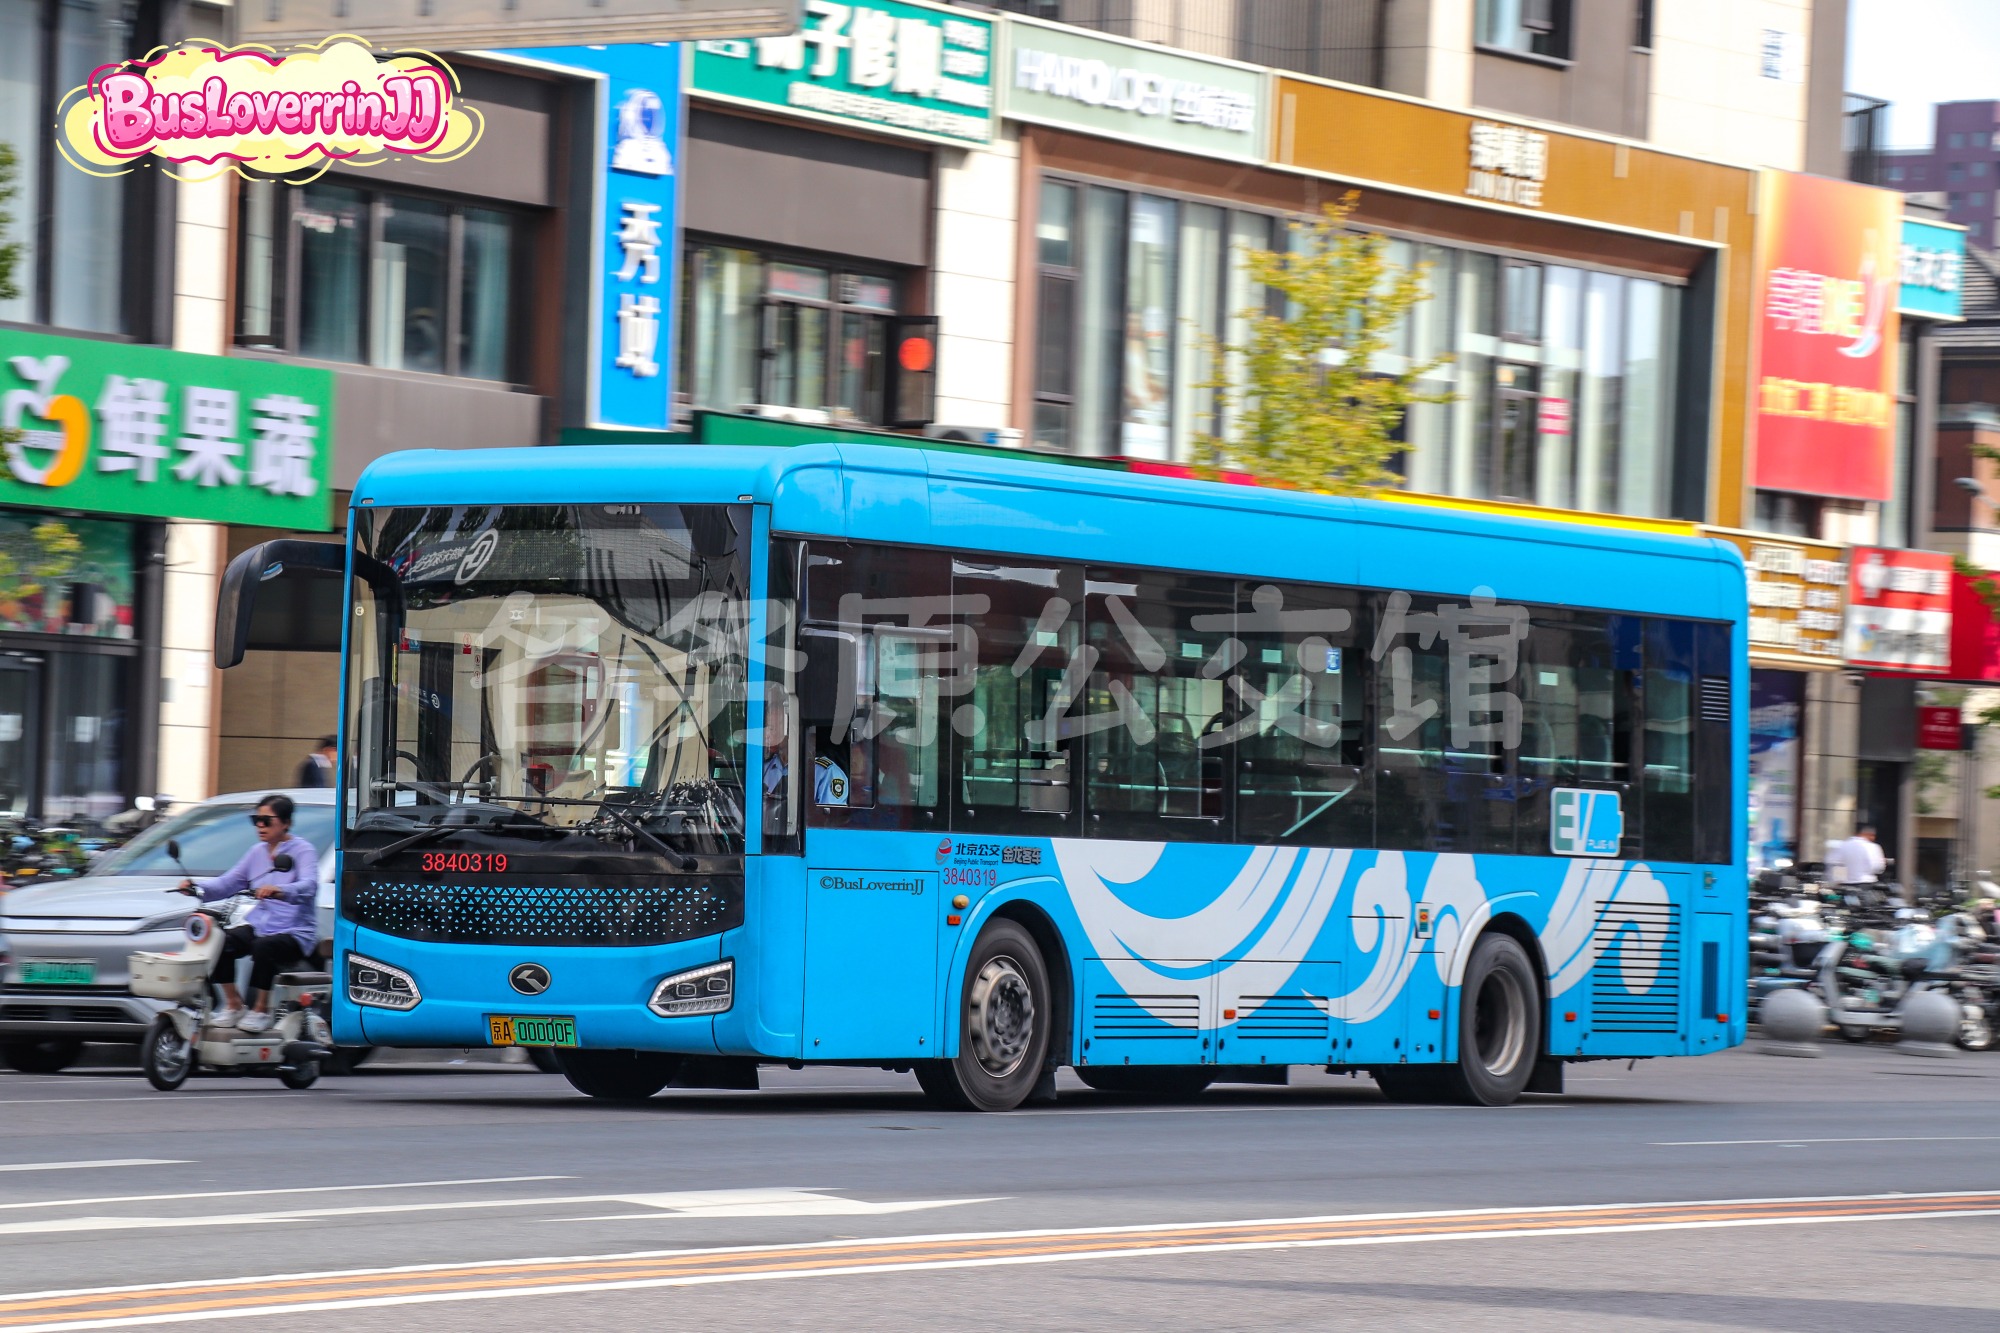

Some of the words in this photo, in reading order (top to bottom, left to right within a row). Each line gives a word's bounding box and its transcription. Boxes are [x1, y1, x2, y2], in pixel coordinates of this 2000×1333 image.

[95, 374, 318, 498] 鲜果蔬
[955, 842, 1000, 857] 北京公交
[1002, 846, 1042, 865] 金龙客车
[421, 853, 508, 873] 3840319
[953, 857, 967, 866] Beijing
[967, 858, 979, 866] Public
[943, 867, 997, 887] 3840319
